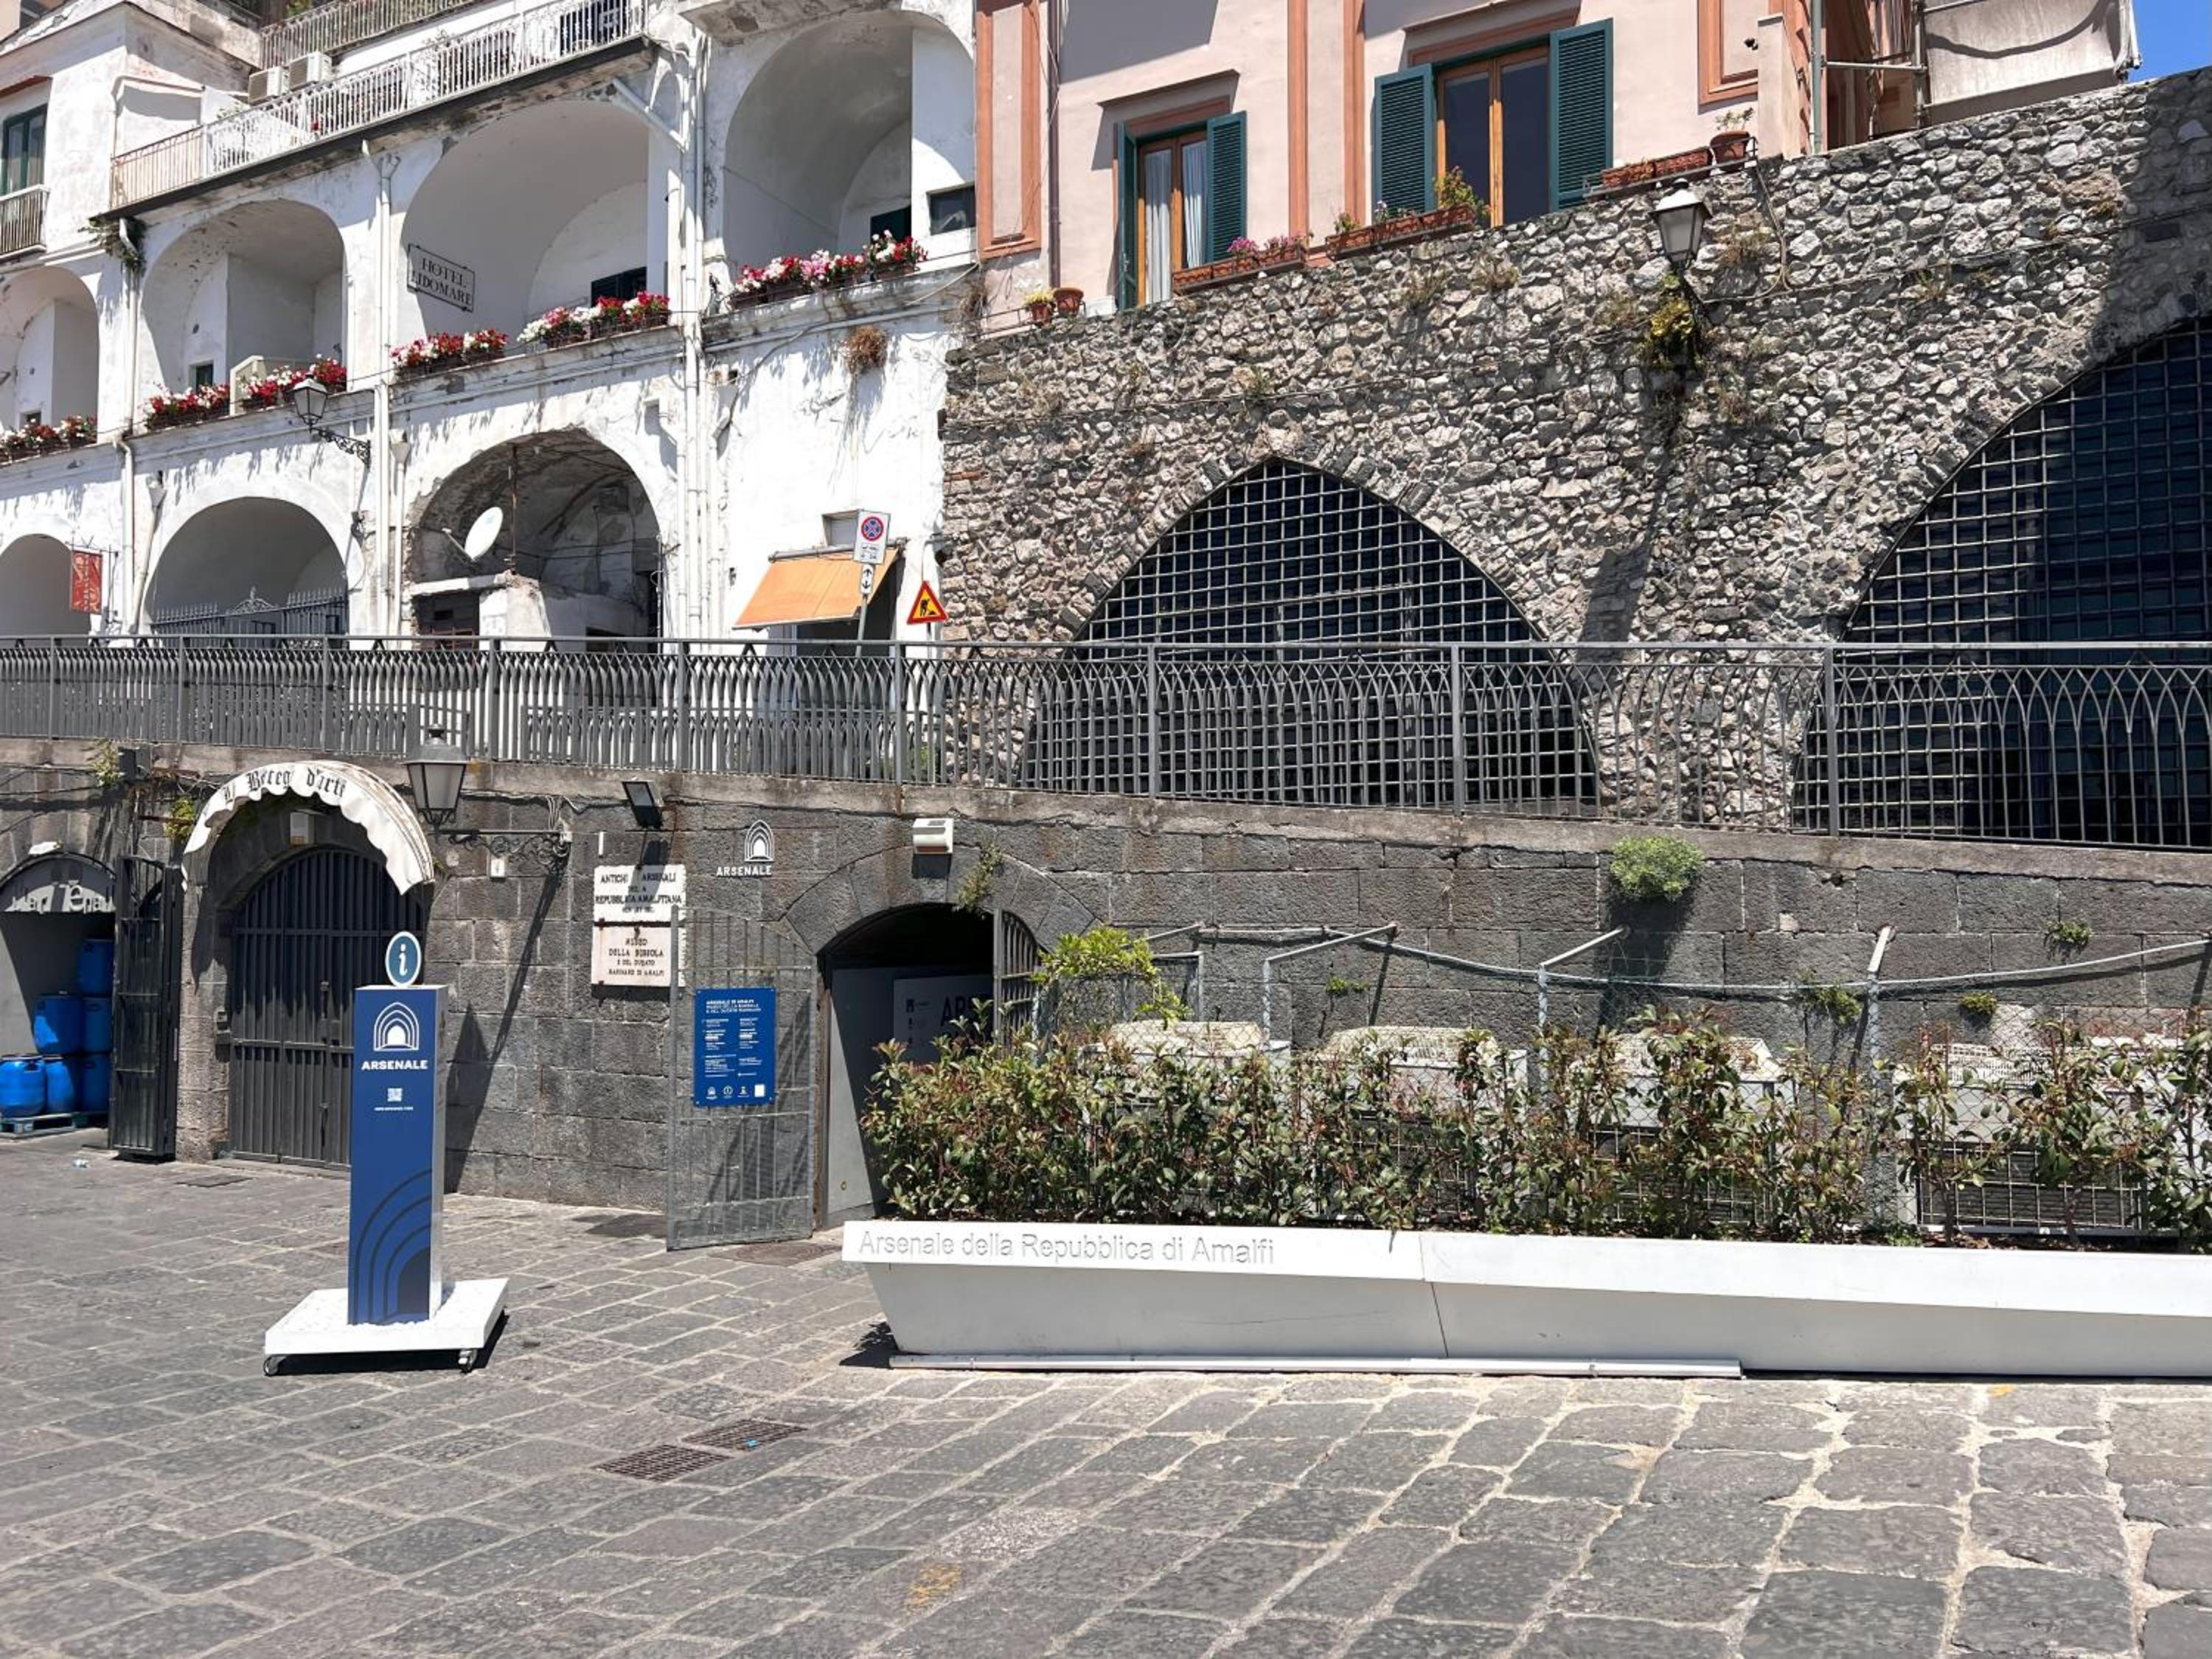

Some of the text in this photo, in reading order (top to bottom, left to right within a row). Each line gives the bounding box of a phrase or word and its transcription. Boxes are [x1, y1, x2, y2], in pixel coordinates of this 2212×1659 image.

[422, 258, 467, 288] HOTEL
[716, 866, 772, 877] ARSENALE
[608, 948, 630, 956] DELLA
[361, 1060, 428, 1070] ARSENALE
[859, 1231, 1273, 1265] Arsenale della Repubblica di Amalfi
